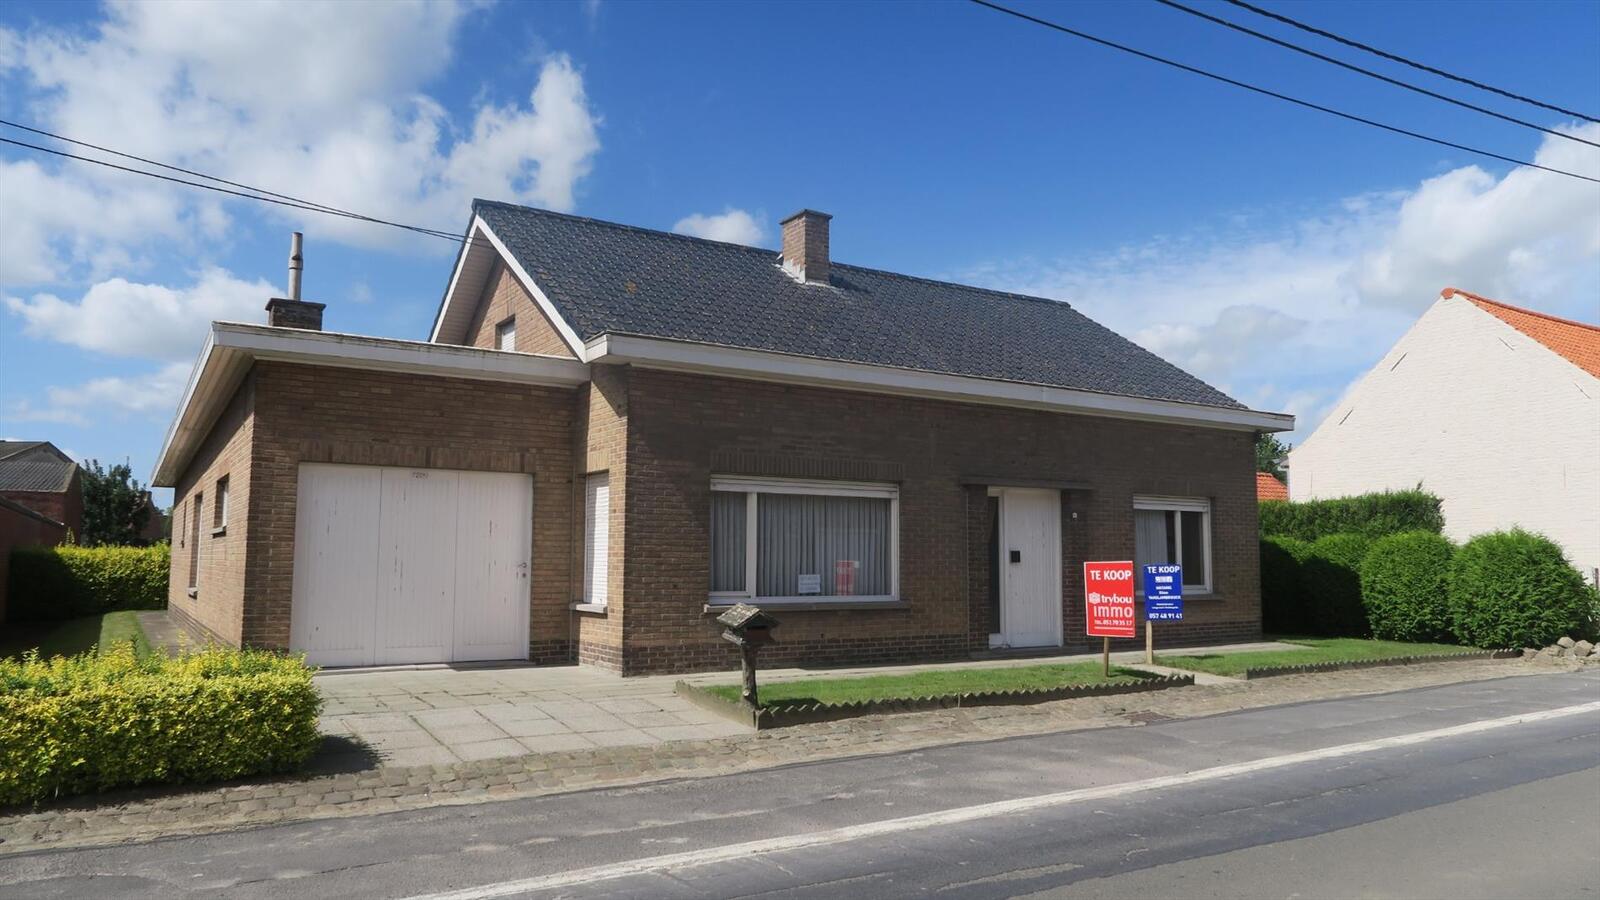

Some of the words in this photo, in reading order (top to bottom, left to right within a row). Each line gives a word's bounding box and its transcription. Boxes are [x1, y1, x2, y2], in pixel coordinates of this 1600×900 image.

[1090, 570, 1101, 580] TE
[1103, 570, 1132, 580] KOOP
[1101, 593, 1132, 606] trybou
